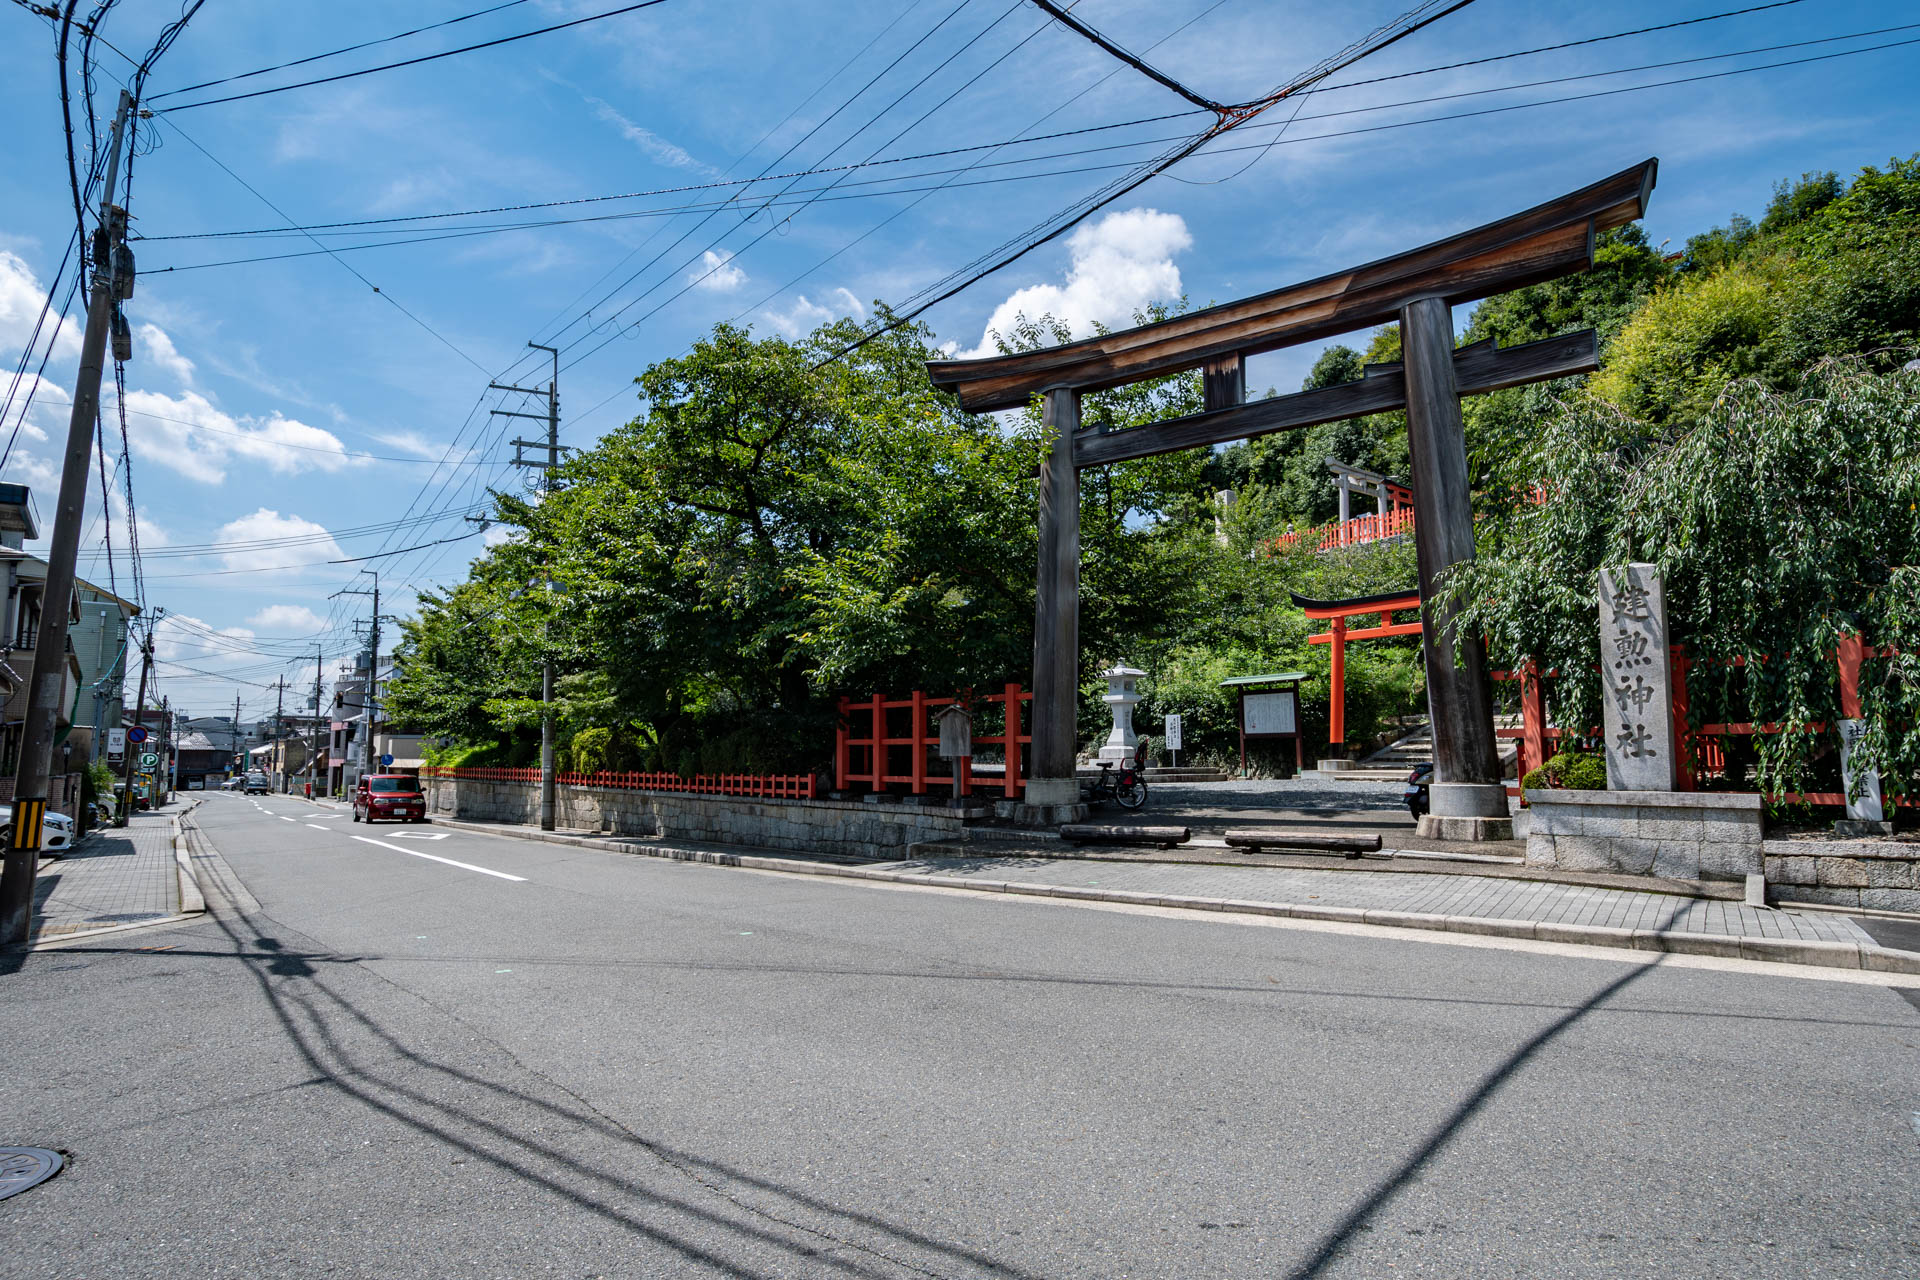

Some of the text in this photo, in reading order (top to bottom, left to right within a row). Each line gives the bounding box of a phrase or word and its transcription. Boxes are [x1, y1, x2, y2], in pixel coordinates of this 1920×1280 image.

[1612, 585, 1657, 759] 建勲神社
[146, 755, 156, 764] P
